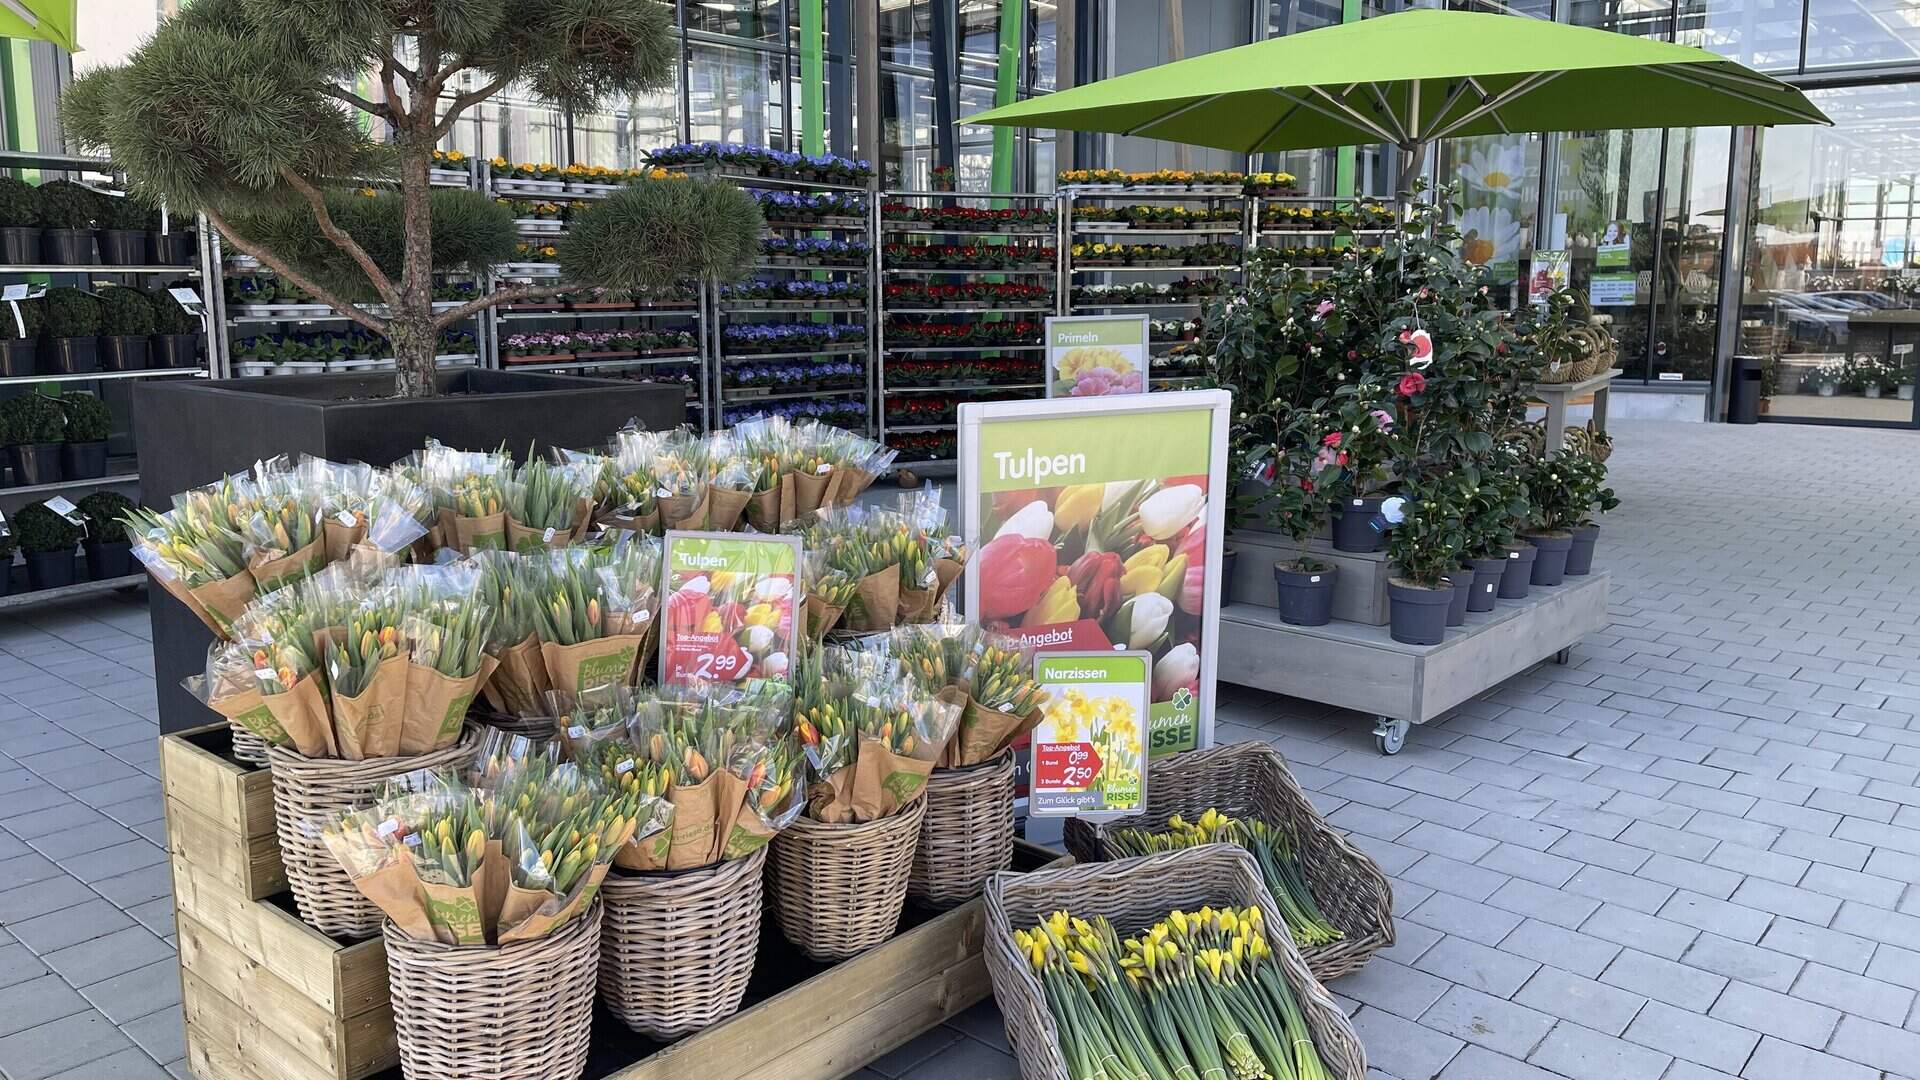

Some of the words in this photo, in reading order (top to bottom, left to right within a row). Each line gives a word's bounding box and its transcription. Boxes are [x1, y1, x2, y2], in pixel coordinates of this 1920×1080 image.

[1058, 331, 1099, 344] Primeln
[993, 448, 1086, 484] Tulpen
[679, 552, 728, 568] Tulpen
[676, 633, 719, 643] Top-Angebot
[695, 653, 737, 679] 2.99
[1045, 667, 1107, 680] Narzissen
[1149, 713, 1192, 730] umen
[1150, 725, 1191, 748] SSE
[1042, 744, 1081, 752] Top-Angebot
[1062, 766, 1092, 786] 2.50
[1038, 797, 1054, 805] Zum
[1055, 796, 1076, 805] Glück
[1076, 795, 1096, 806] gibt's
[1106, 792, 1138, 801] RISSE
